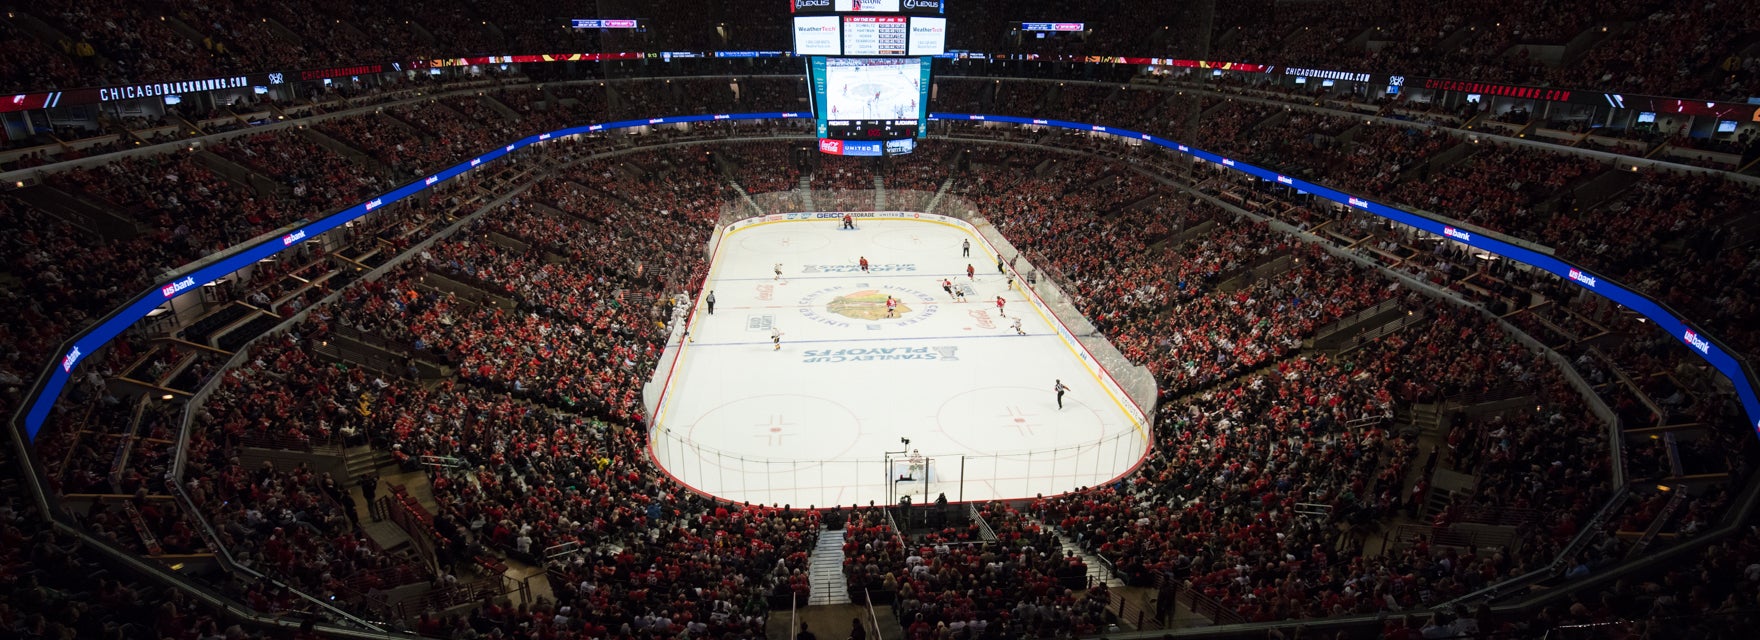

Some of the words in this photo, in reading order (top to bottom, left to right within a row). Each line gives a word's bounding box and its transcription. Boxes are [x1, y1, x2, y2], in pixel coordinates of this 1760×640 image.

[100, 76, 248, 101] CHICAGOBLACKHAWKS.COM
[1425, 79, 1571, 102] CHICAGOBLACKHAWKS.COM
[803, 346, 929, 357] PLAYOFFS
[849, 352, 938, 362] STANLEY
[802, 355, 847, 363] CUP
